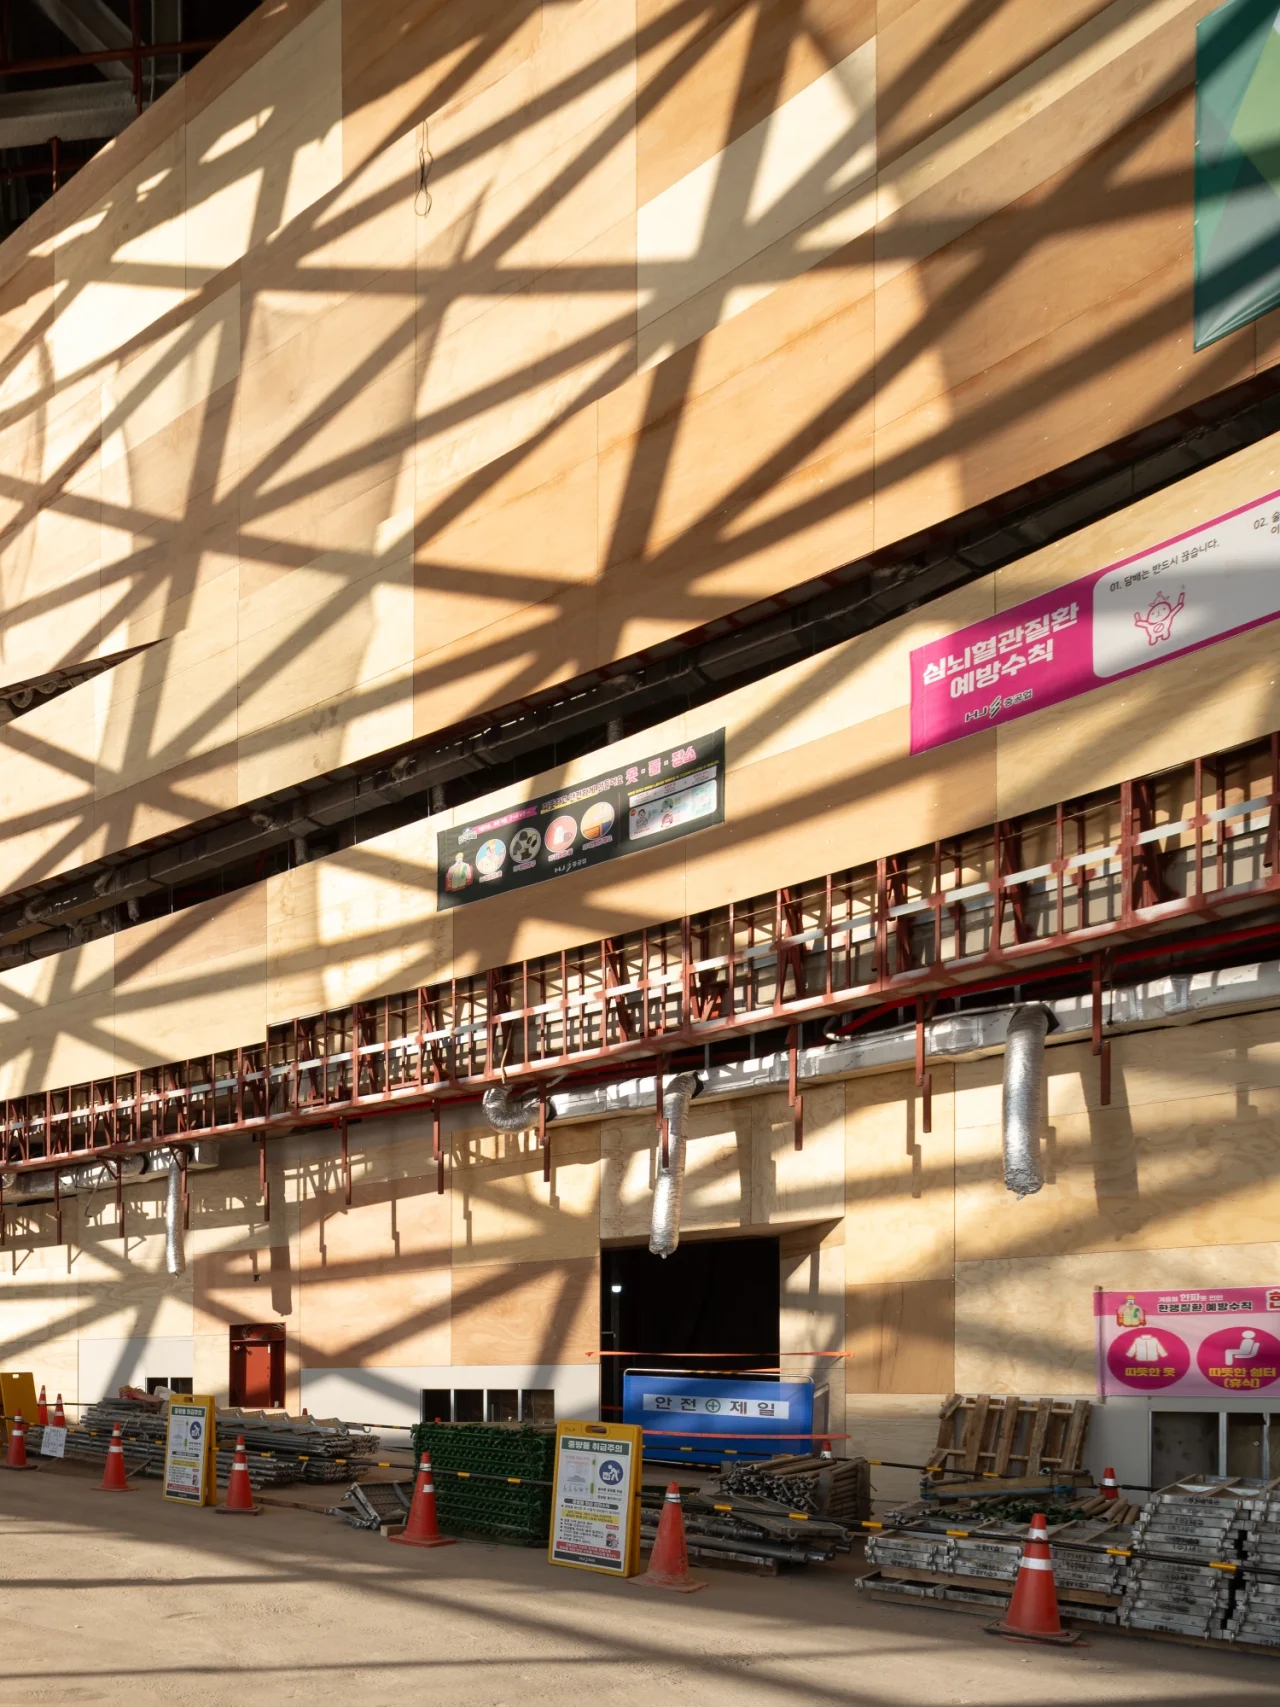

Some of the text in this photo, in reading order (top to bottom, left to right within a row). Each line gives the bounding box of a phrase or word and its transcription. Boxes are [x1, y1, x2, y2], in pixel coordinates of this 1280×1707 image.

[1109, 581, 1123, 593] 01.
[1124, 569, 1150, 588] 담배는
[1152, 555, 1178, 575] 반드시
[922, 601, 1080, 686] 심뇌혈관질환
[950, 638, 1054, 699] 예방수칙
[964, 688, 1033, 723] HJ 중공업
[625, 765, 639, 786] 옷
[648, 757, 661, 778] 물
[671, 745, 697, 767] 장소
[1205, 1301, 1253, 1312] 예방수칙
[1124, 1367, 1176, 1378] 따뜻한 옷
[1208, 1367, 1247, 1378] 따뜻한
[567, 1440, 623, 1453] 중량물 취급주의
